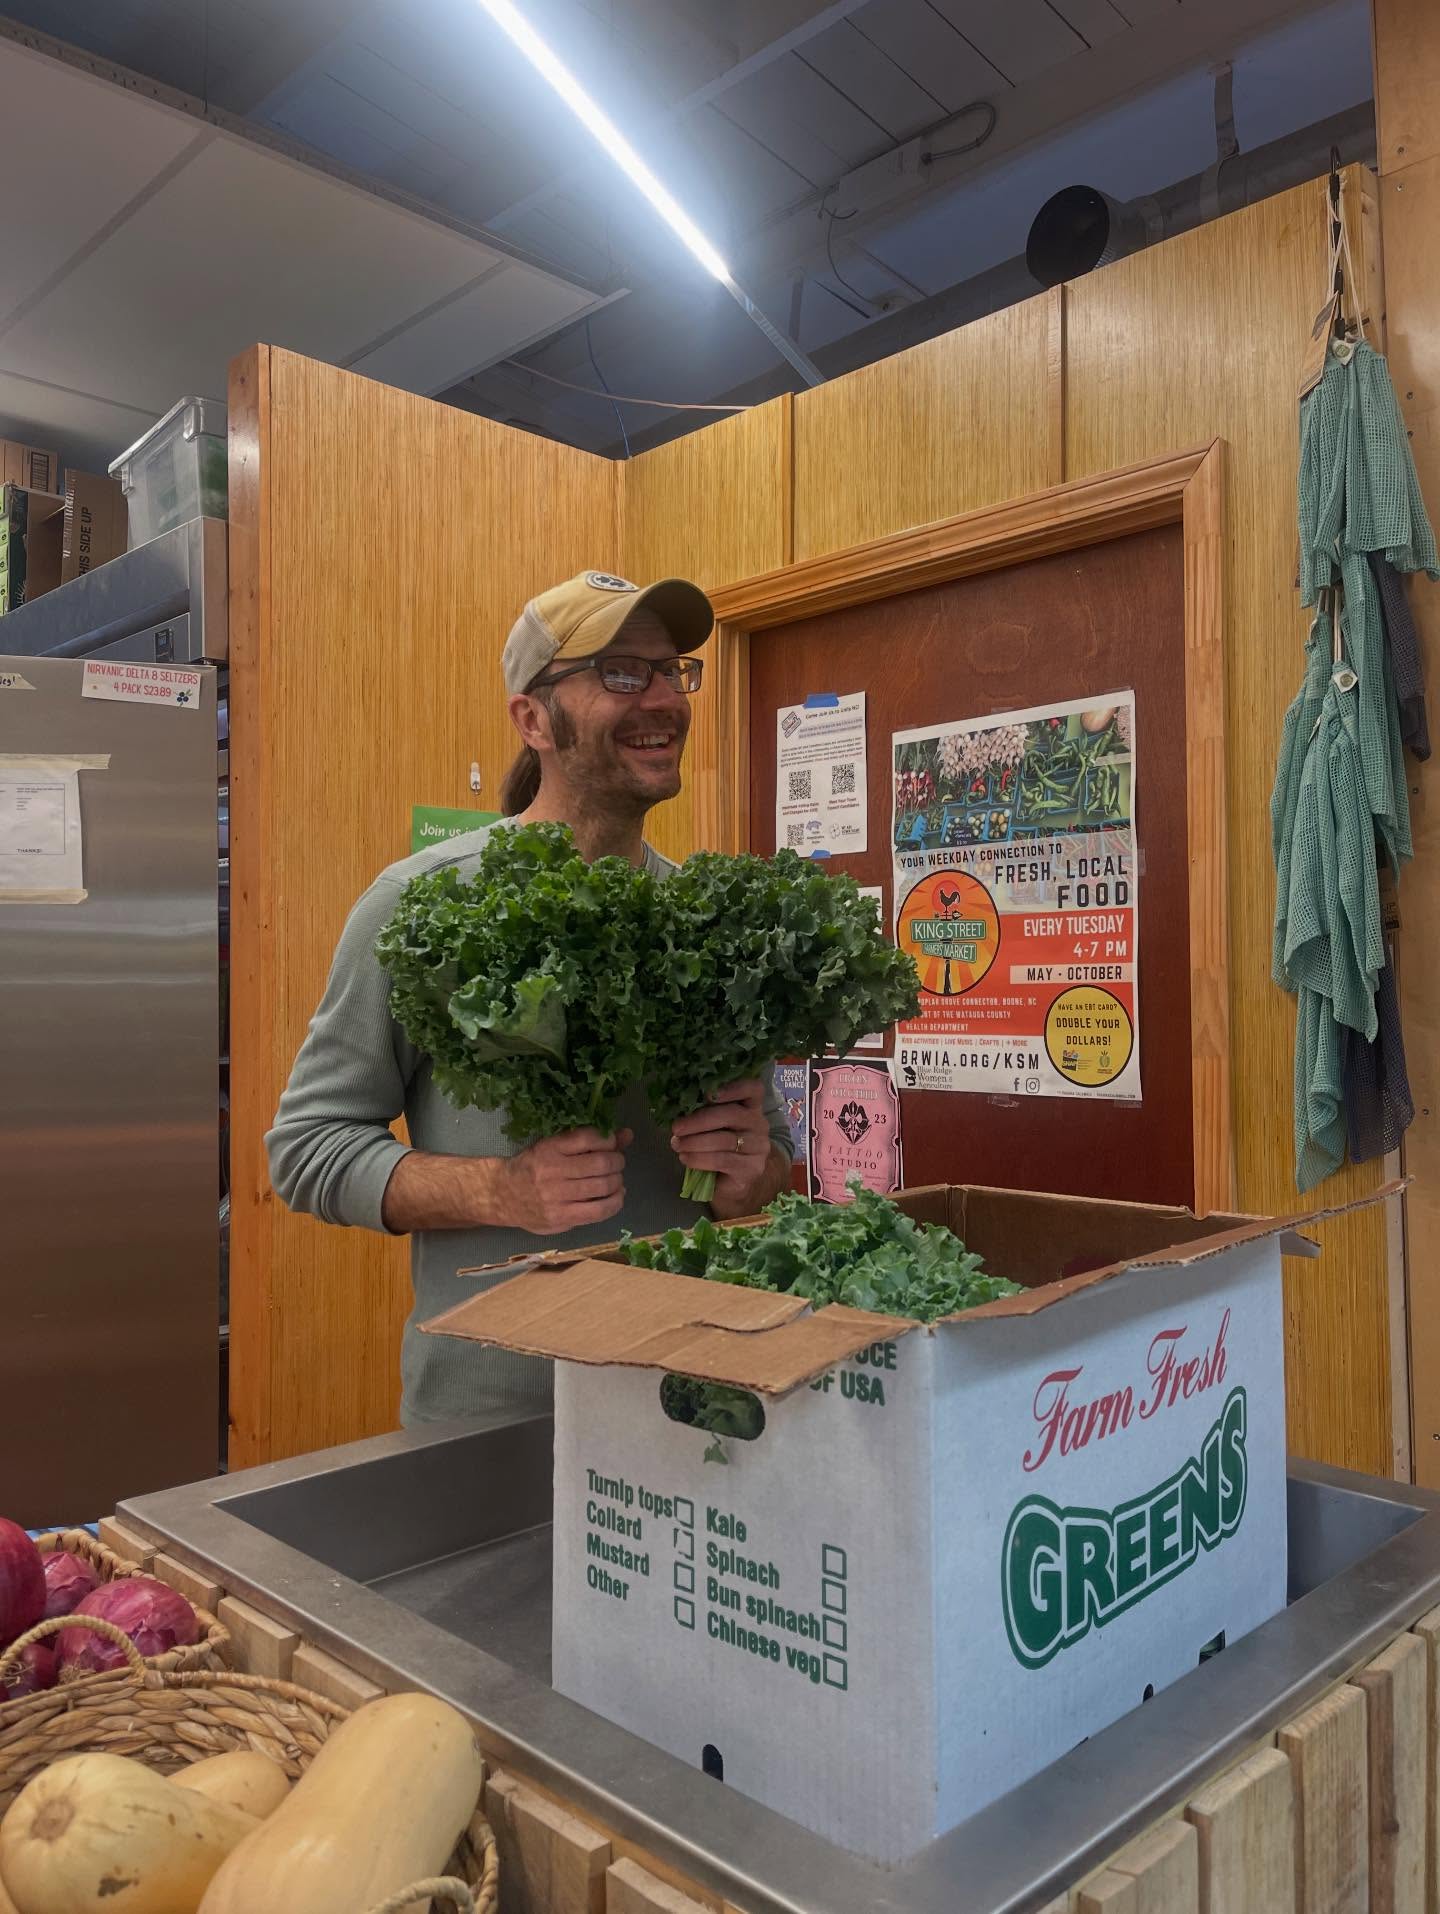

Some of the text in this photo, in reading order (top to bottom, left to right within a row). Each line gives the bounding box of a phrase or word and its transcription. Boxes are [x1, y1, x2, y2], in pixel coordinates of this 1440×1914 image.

[79, 506, 92, 577] HIS SIDE UP
[87, 664, 198, 684] NIRVANIC DELTA 8 SELTZERS
[114, 684, 119, 692] 4
[122, 684, 141, 694] PACK
[420, 822, 445, 836] Join
[901, 843, 1062, 868] YOUR WEEKDAY CONNECTION TO
[995, 855, 1128, 884] FRESH, LOCAL
[1058, 881, 1128, 909] FOOD
[914, 922, 982, 940] KING STREET
[1024, 914, 1124, 937] EVERY TUESDAY
[944, 945, 974, 960] MARKET
[1073, 941, 1127, 958] 4-7 PM
[1027, 968, 1053, 980] MAY
[1067, 966, 1122, 980] OCTOBER
[987, 1011, 1011, 1019] COUNTY
[1056, 1018, 1120, 1028] DOUBLE YOUR
[930, 1024, 968, 1032] DEPARTMENT
[1066, 1035, 1111, 1046] DOLLARS!
[901, 1050, 1039, 1070] BRWIA.ORG/KSM
[918, 1073, 947, 1081] Women
[934, 1066, 952, 1075] Ridge
[824, 1110, 887, 1124] 20 23
[828, 1145, 883, 1159] TATTOO
[832, 1158, 877, 1169] STUDIO
[840, 1370, 886, 1407] USA
[1022, 1308, 1231, 1472] Farm Fresh
[586, 1468, 673, 1519] Turnip tops
[587, 1501, 642, 1540] Collard
[706, 1506, 746, 1542] Kale
[1002, 1385, 1248, 1670] GREENS
[587, 1532, 649, 1576] Mustard
[706, 1541, 779, 1589] Spinach
[587, 1564, 629, 1600] Other
[707, 1576, 821, 1641] Bun spinach
[707, 1611, 820, 1684] Chinese veg
